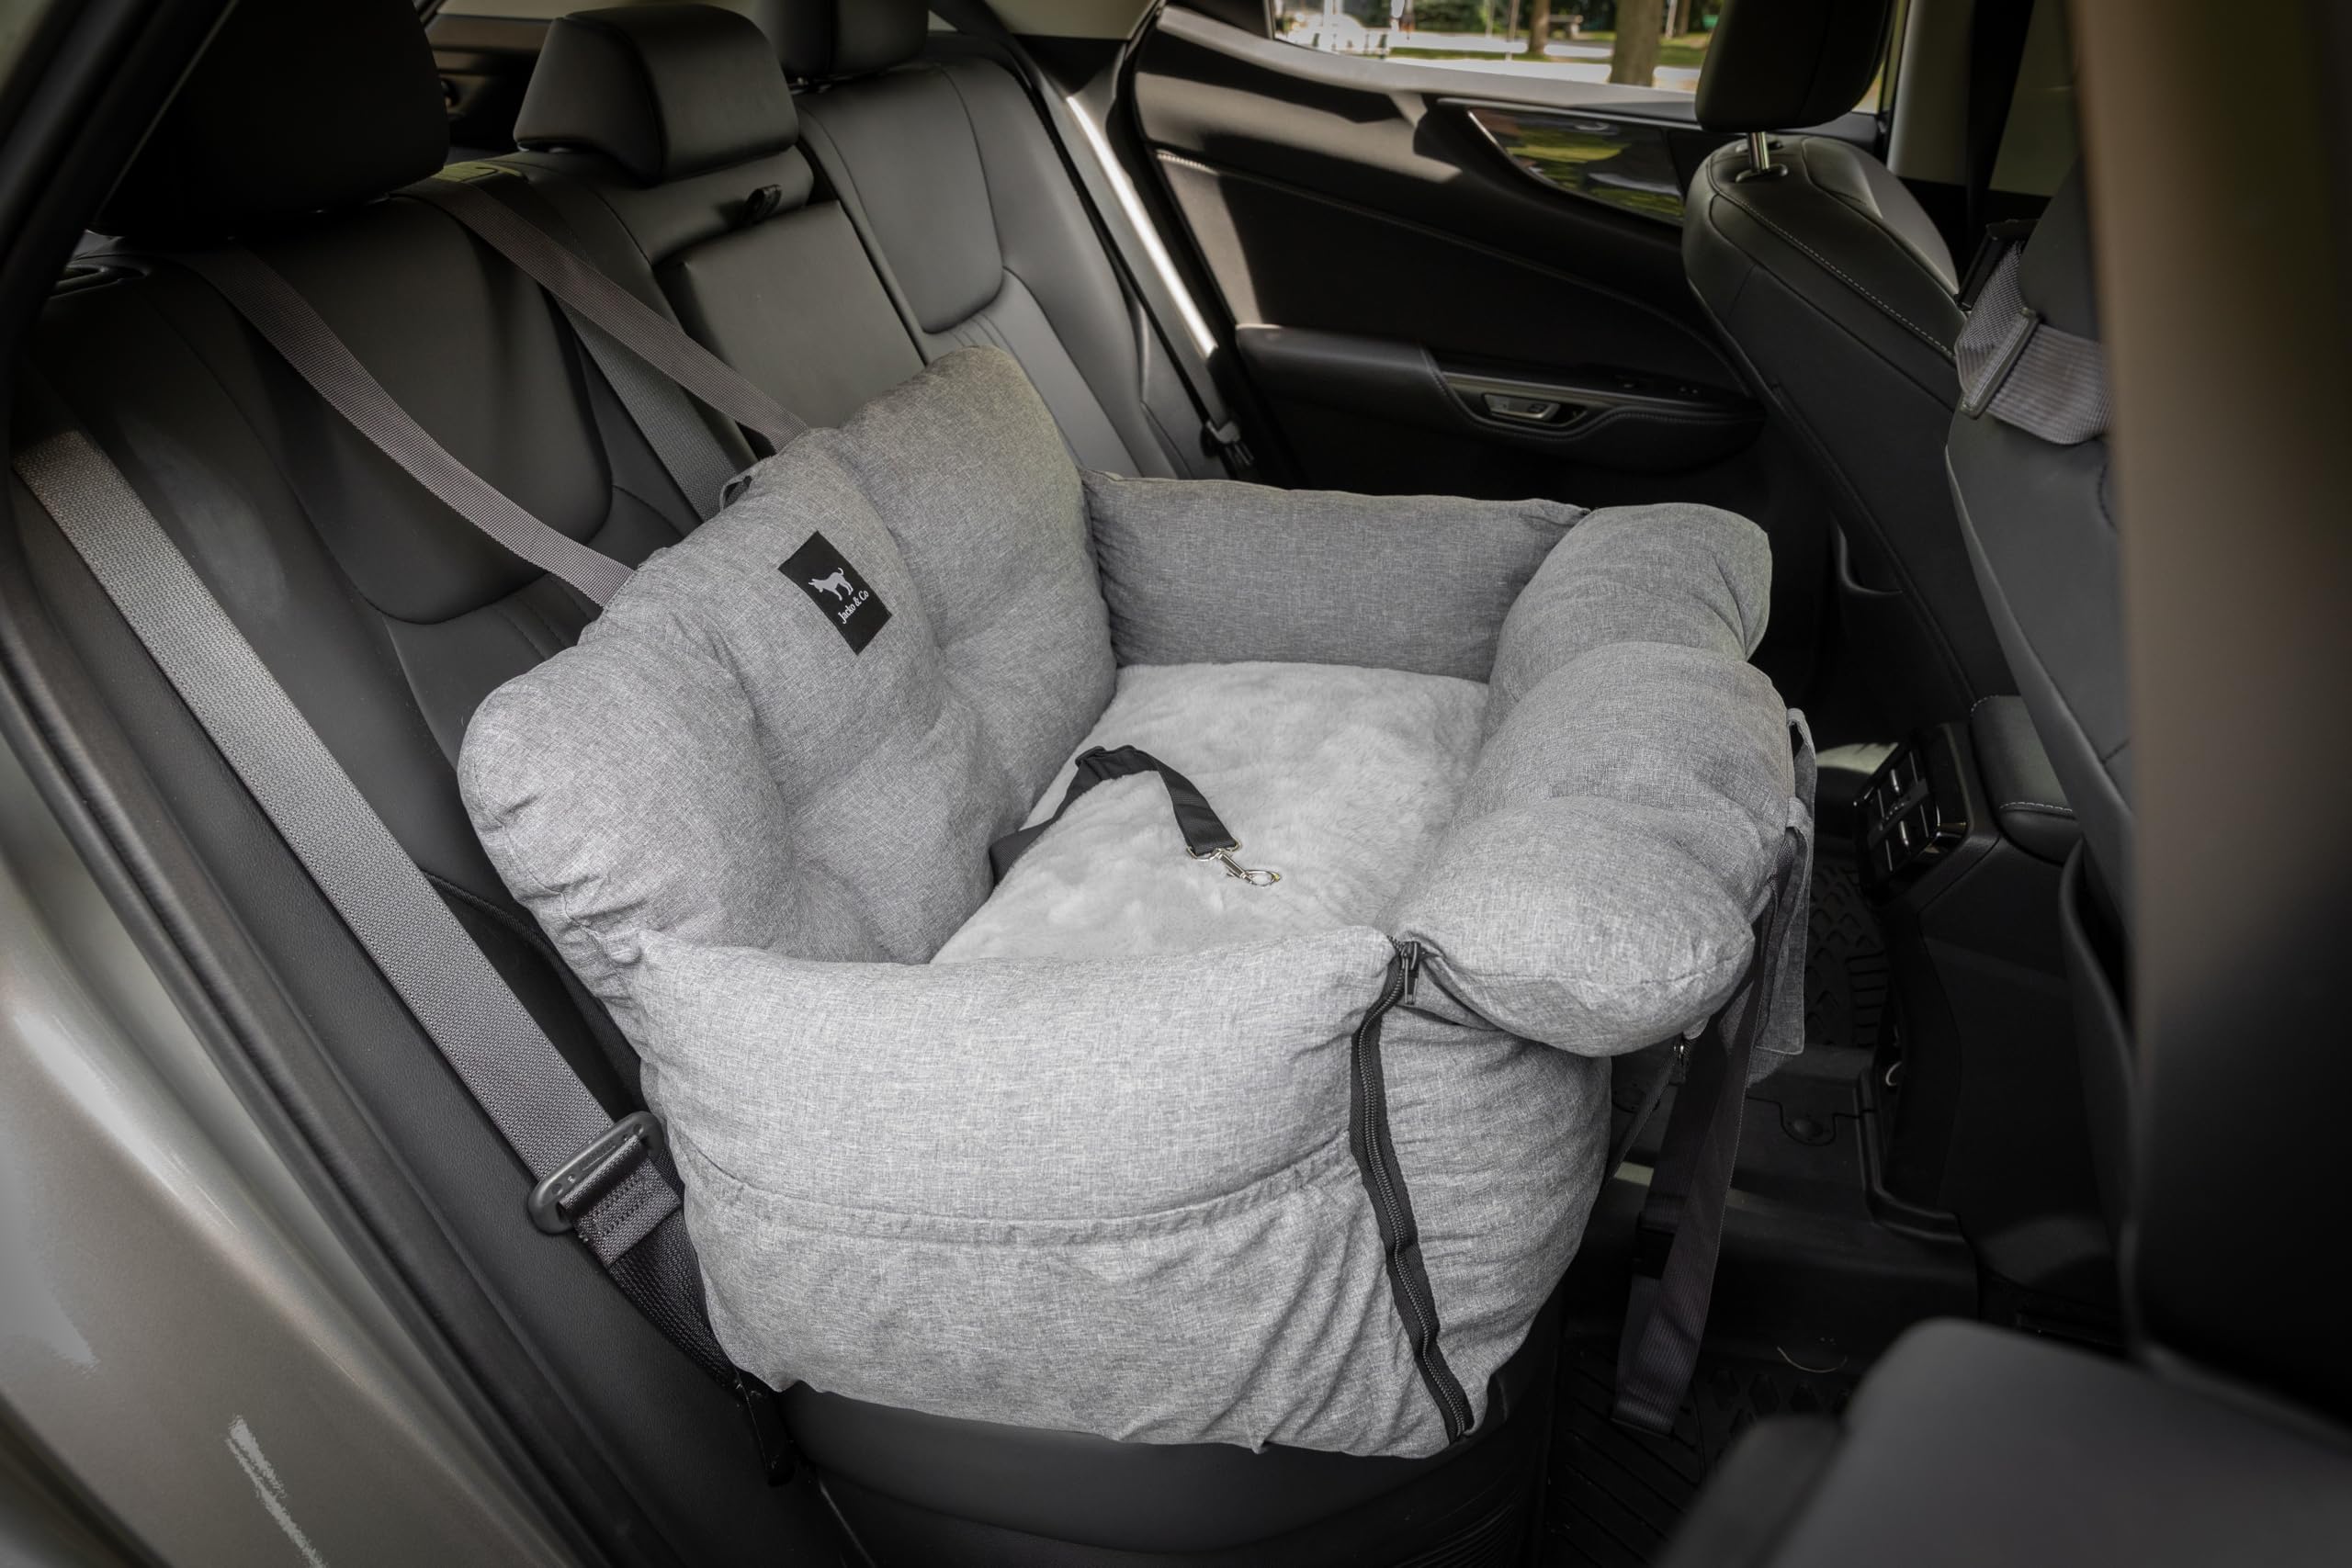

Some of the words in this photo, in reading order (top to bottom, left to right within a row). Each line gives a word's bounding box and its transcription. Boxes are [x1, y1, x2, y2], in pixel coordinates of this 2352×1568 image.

[838, 604, 856, 625] Jacko
[853, 596, 862, 606] &
[858, 590, 869, 601] Co
